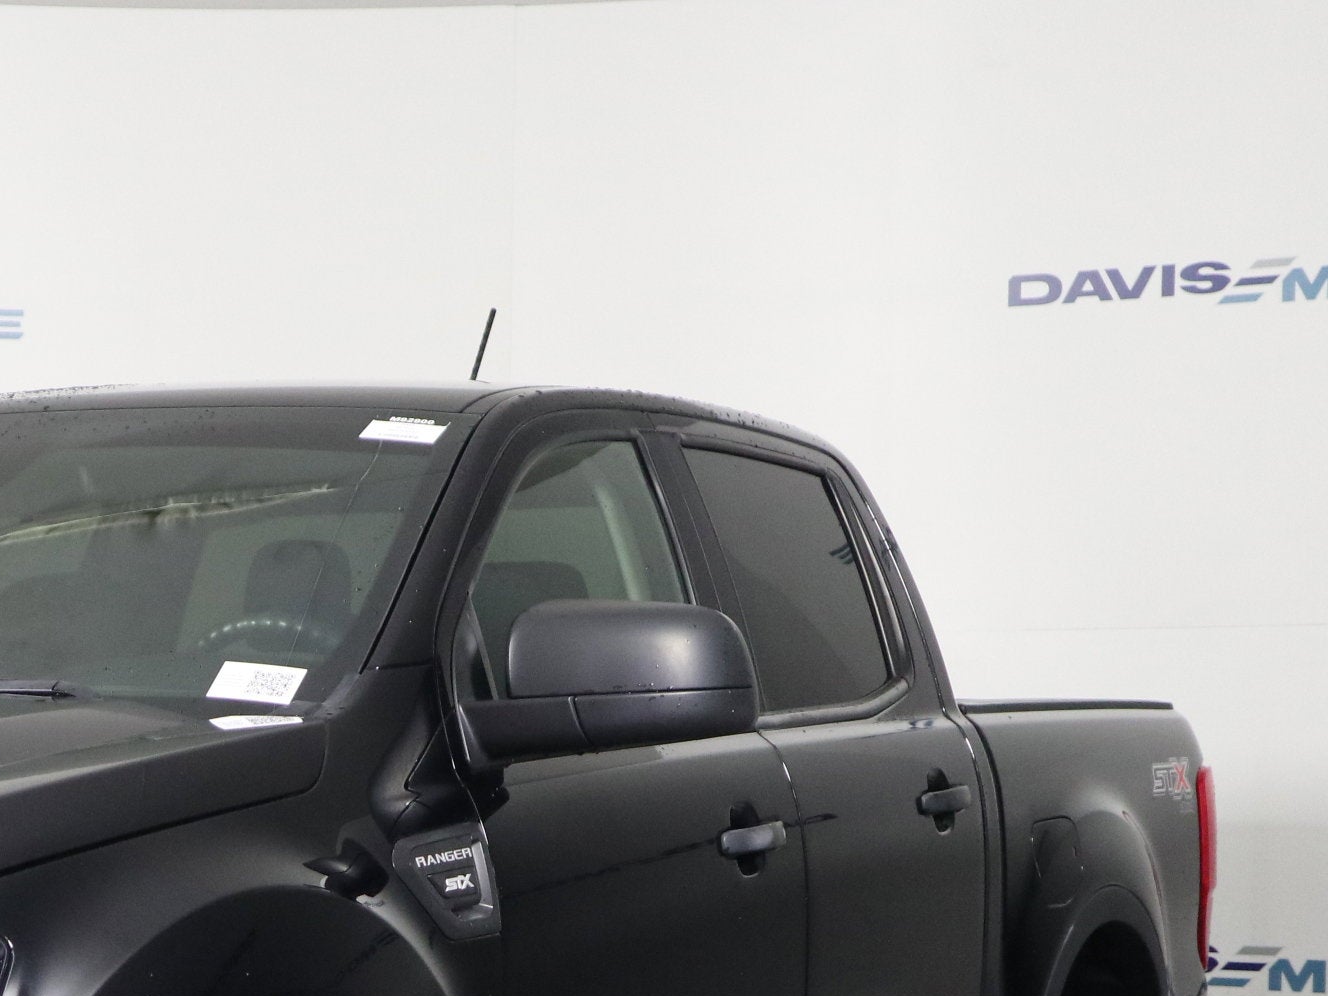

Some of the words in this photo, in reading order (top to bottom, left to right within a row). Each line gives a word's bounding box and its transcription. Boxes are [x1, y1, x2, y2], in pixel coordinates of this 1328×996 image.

[1007, 260, 1232, 308] DAVIS
[414, 846, 473, 868] RANGER
[445, 873, 475, 892] STX
